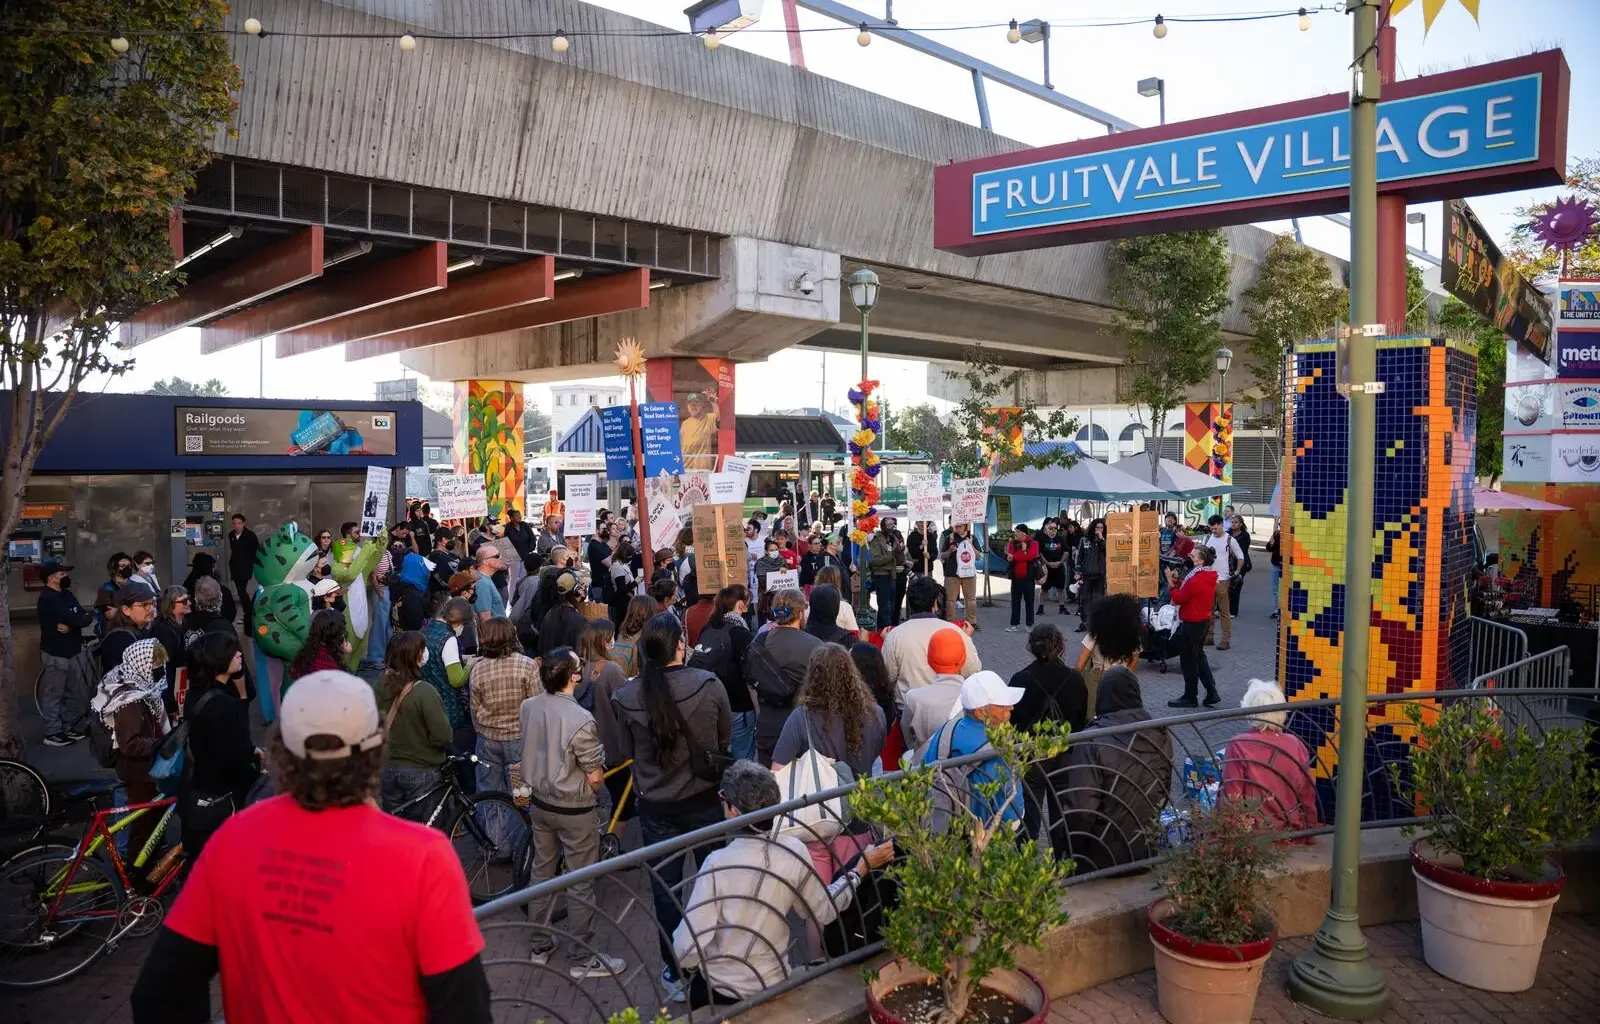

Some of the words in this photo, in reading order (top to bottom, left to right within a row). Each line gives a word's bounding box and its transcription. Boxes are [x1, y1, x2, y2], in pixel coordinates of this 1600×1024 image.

[980, 146, 1217, 223] FRUITVALE
[1236, 96, 1514, 185] VILLAGE
[186, 414, 246, 426] Railgoods
